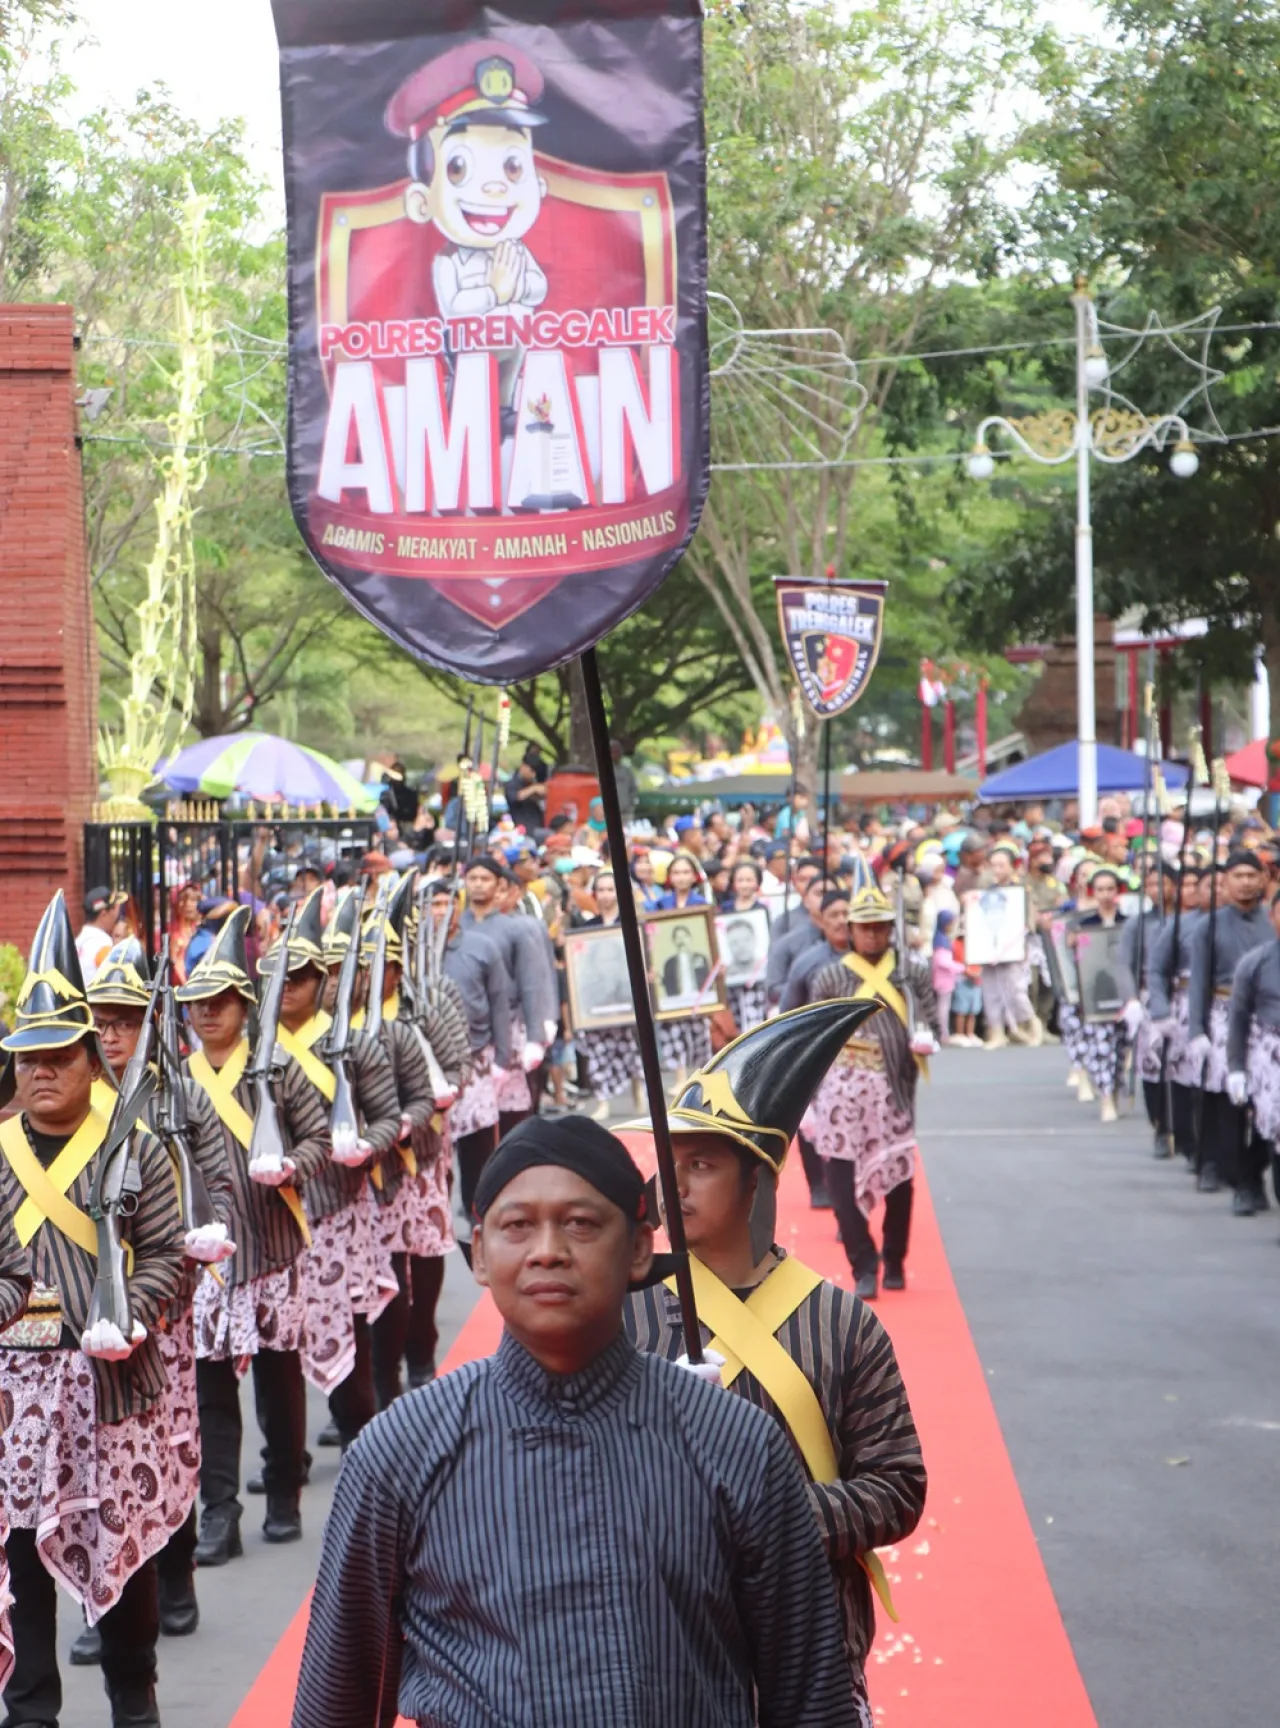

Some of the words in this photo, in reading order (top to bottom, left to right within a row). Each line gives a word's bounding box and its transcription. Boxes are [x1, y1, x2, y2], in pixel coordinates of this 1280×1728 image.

[321, 319, 444, 359] POLRES
[445, 307, 674, 350] TRENGGALEK
[317, 345, 681, 514] AMAN
[322, 523, 385, 555] AGAMIS
[397, 535, 477, 560] MERAKYAT
[494, 529, 568, 560] AMANAH
[582, 510, 677, 552] NASIONALIS
[805, 592, 857, 615] POLRES
